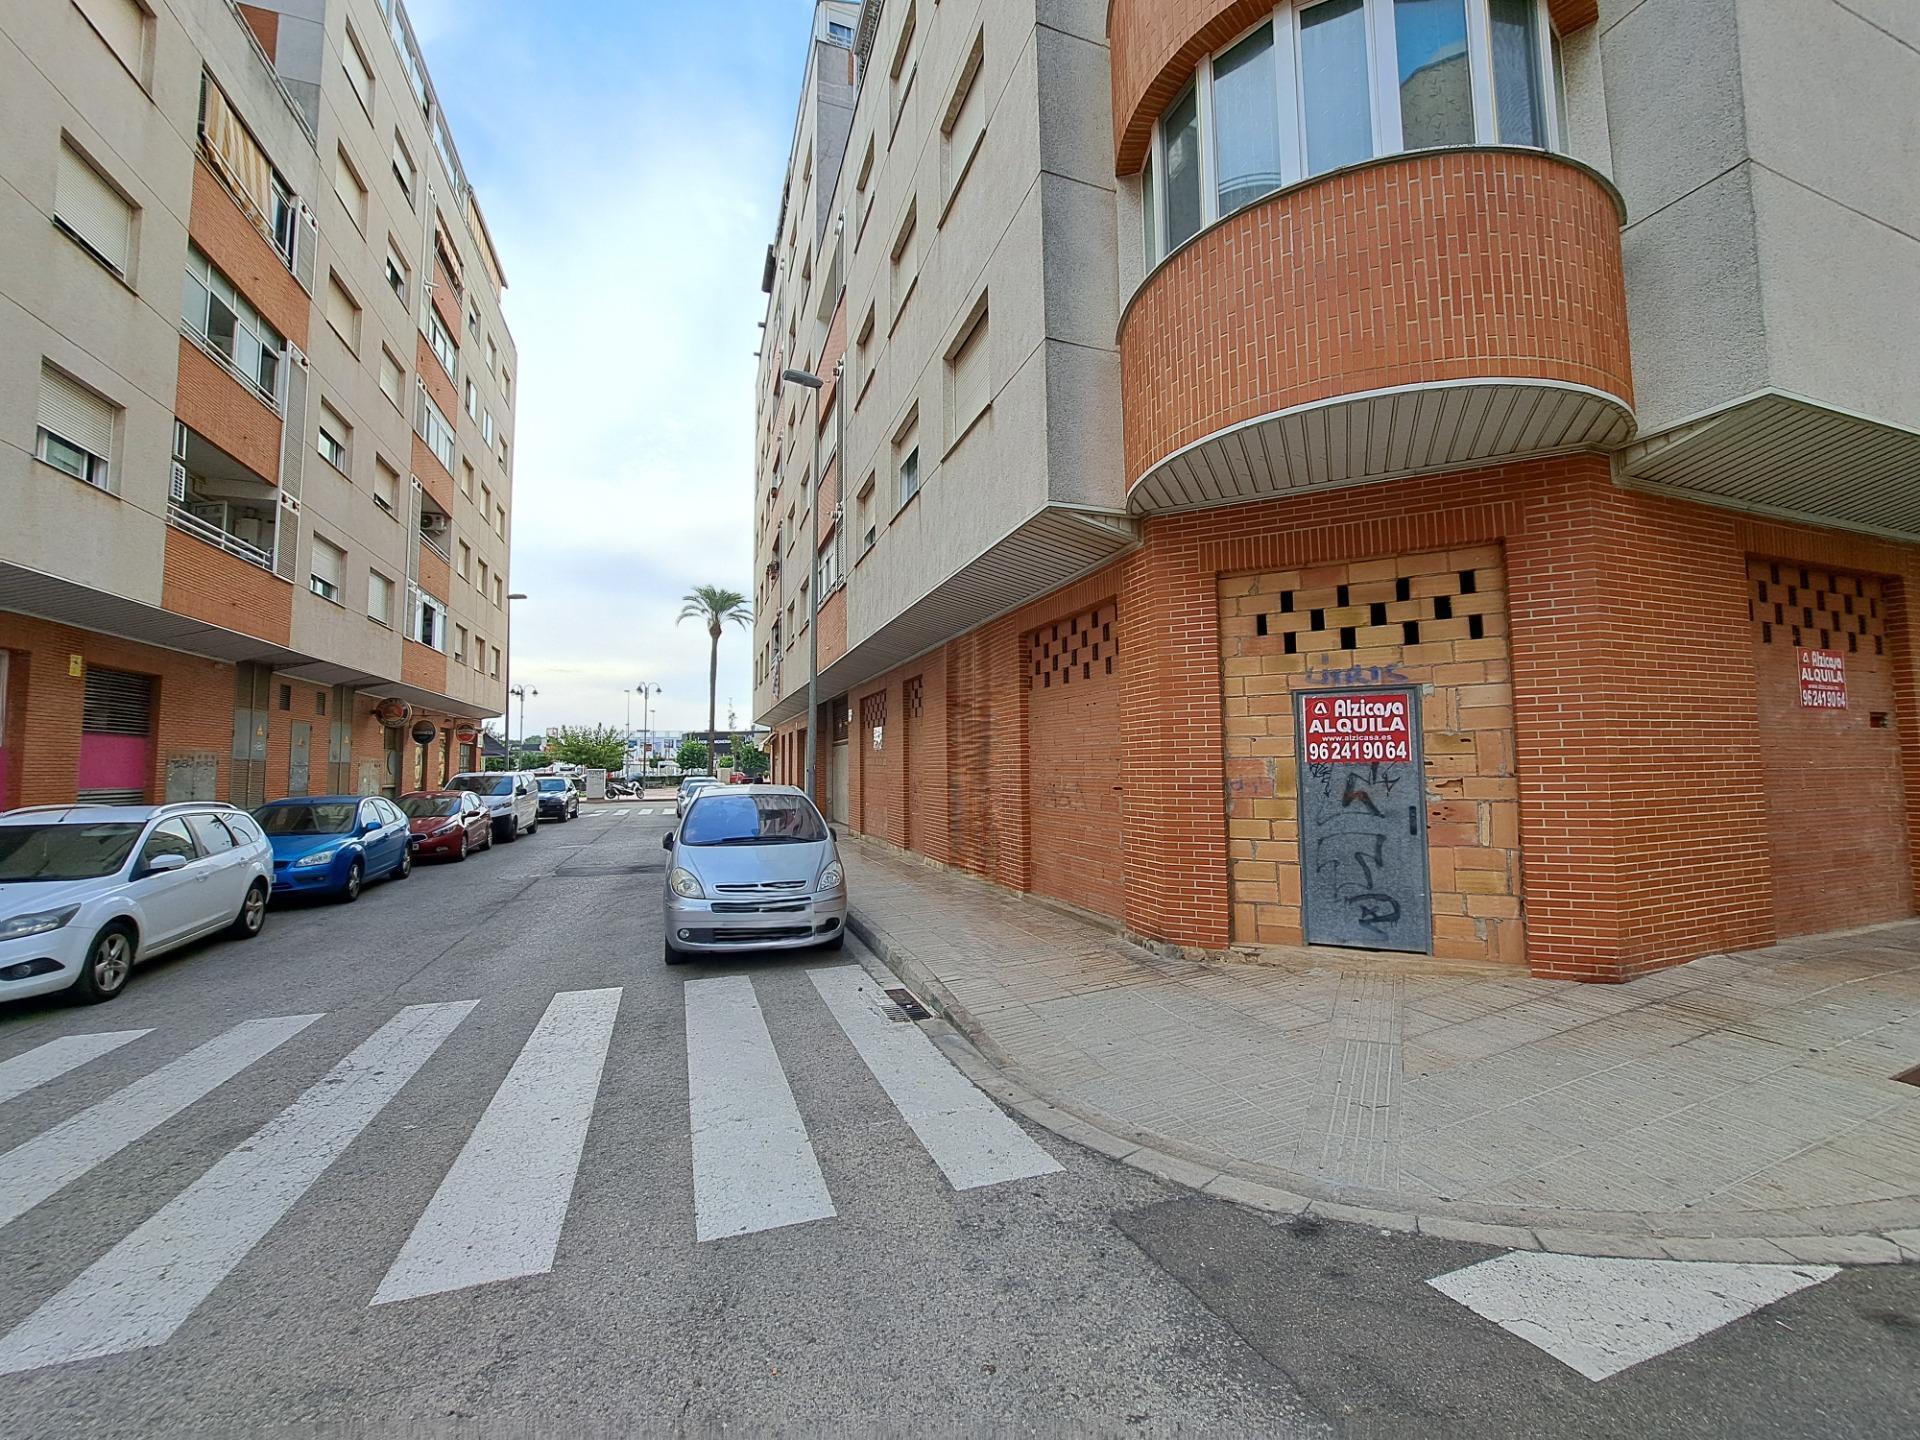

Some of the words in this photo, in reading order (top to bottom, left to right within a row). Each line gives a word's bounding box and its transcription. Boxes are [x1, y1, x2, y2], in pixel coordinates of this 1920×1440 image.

[1802, 667, 1844, 683] ALQUILA
[1334, 699, 1404, 718] Alzicasa
[1309, 716, 1406, 734] ALQUILA
[1321, 734, 1392, 742] www.alzicasa.es
